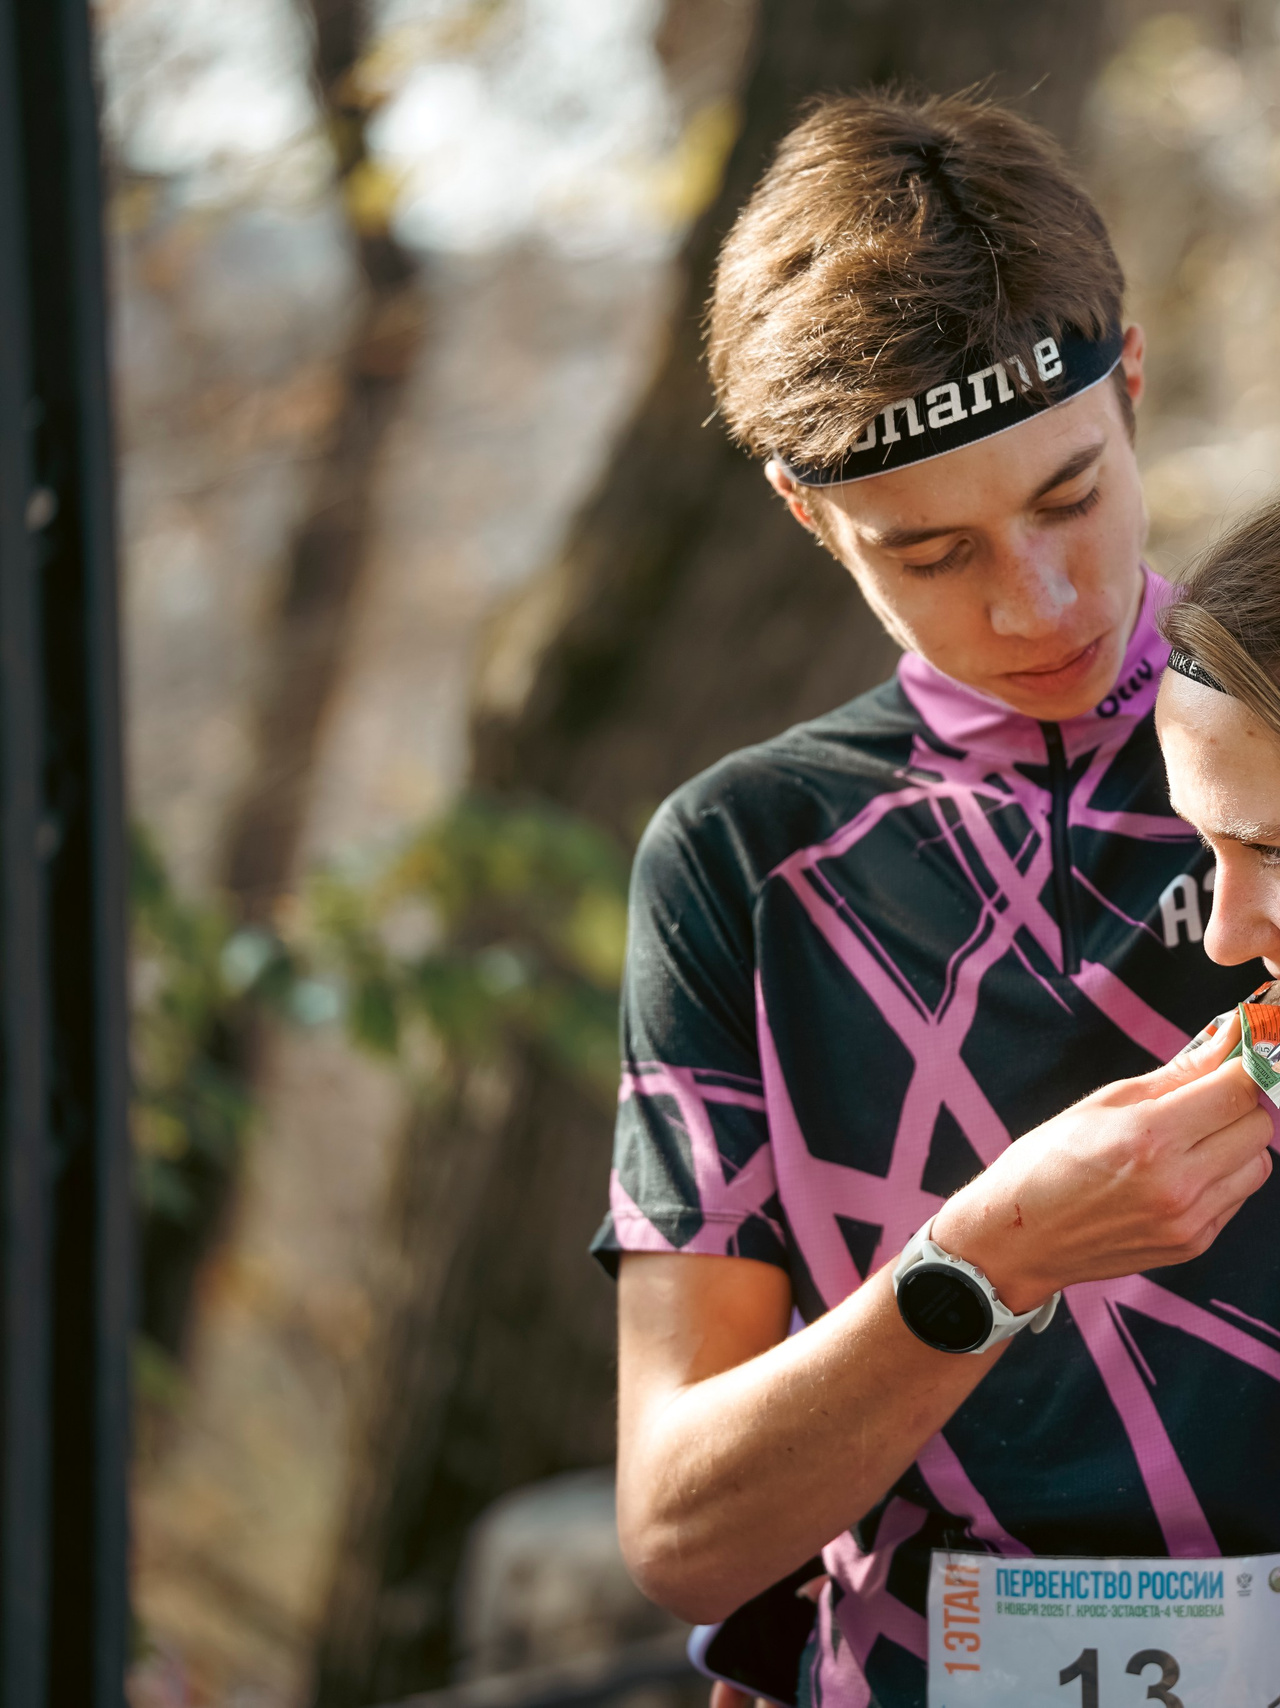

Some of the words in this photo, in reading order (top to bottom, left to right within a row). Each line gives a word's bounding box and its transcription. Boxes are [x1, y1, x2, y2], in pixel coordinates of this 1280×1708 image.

[1170, 650, 1199, 676] NIKE
[996, 1567, 1132, 1600] ПЕРВЕНСТВО
[1138, 1570, 1224, 1600] РОССИИ
[943, 1564, 982, 1653] ЭТАП
[1005, 1602, 1039, 1616] НОЯБРЯ
[1040, 1603, 1065, 1617] 2025
[1173, 1603, 1225, 1618] ЧЕЛОВЕКА
[943, 1662, 981, 1675] 1
[1059, 1648, 1185, 1708] 13
